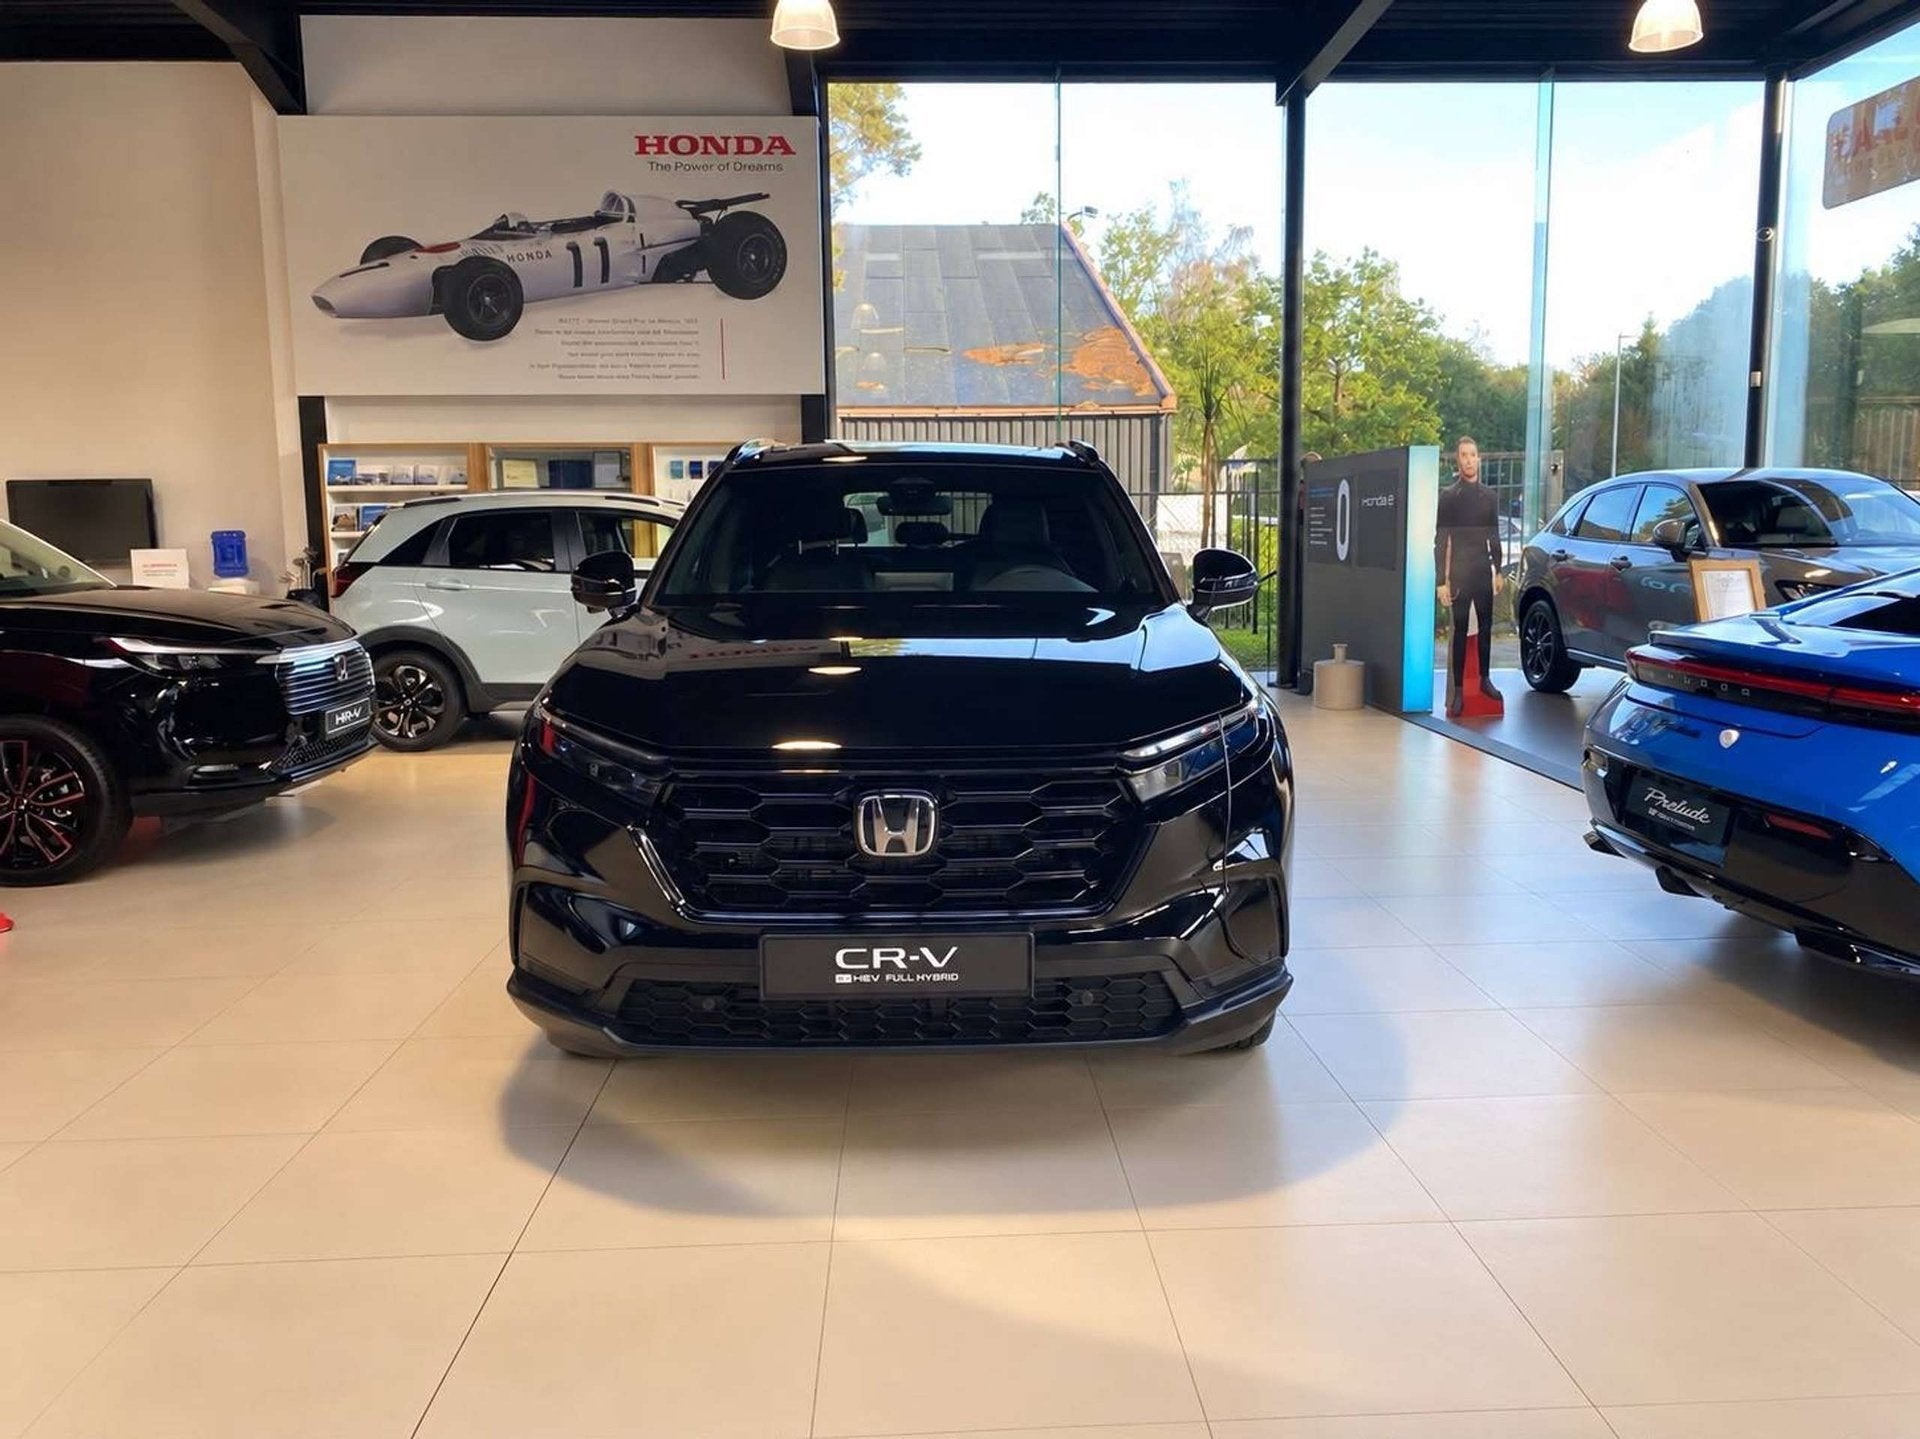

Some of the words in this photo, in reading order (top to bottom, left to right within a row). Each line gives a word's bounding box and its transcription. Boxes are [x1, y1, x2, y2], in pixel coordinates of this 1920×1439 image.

[634, 135, 796, 156] HONDA
[649, 161, 671, 172] The
[675, 161, 713, 172] Power
[717, 161, 730, 172] of
[733, 161, 784, 172] Dreams
[506, 249, 553, 263] HONDA
[1643, 787, 1712, 824] Prelude
[835, 946, 958, 970] CR-V
[885, 974, 915, 983] FULL
[916, 973, 959, 982] HYBRID
